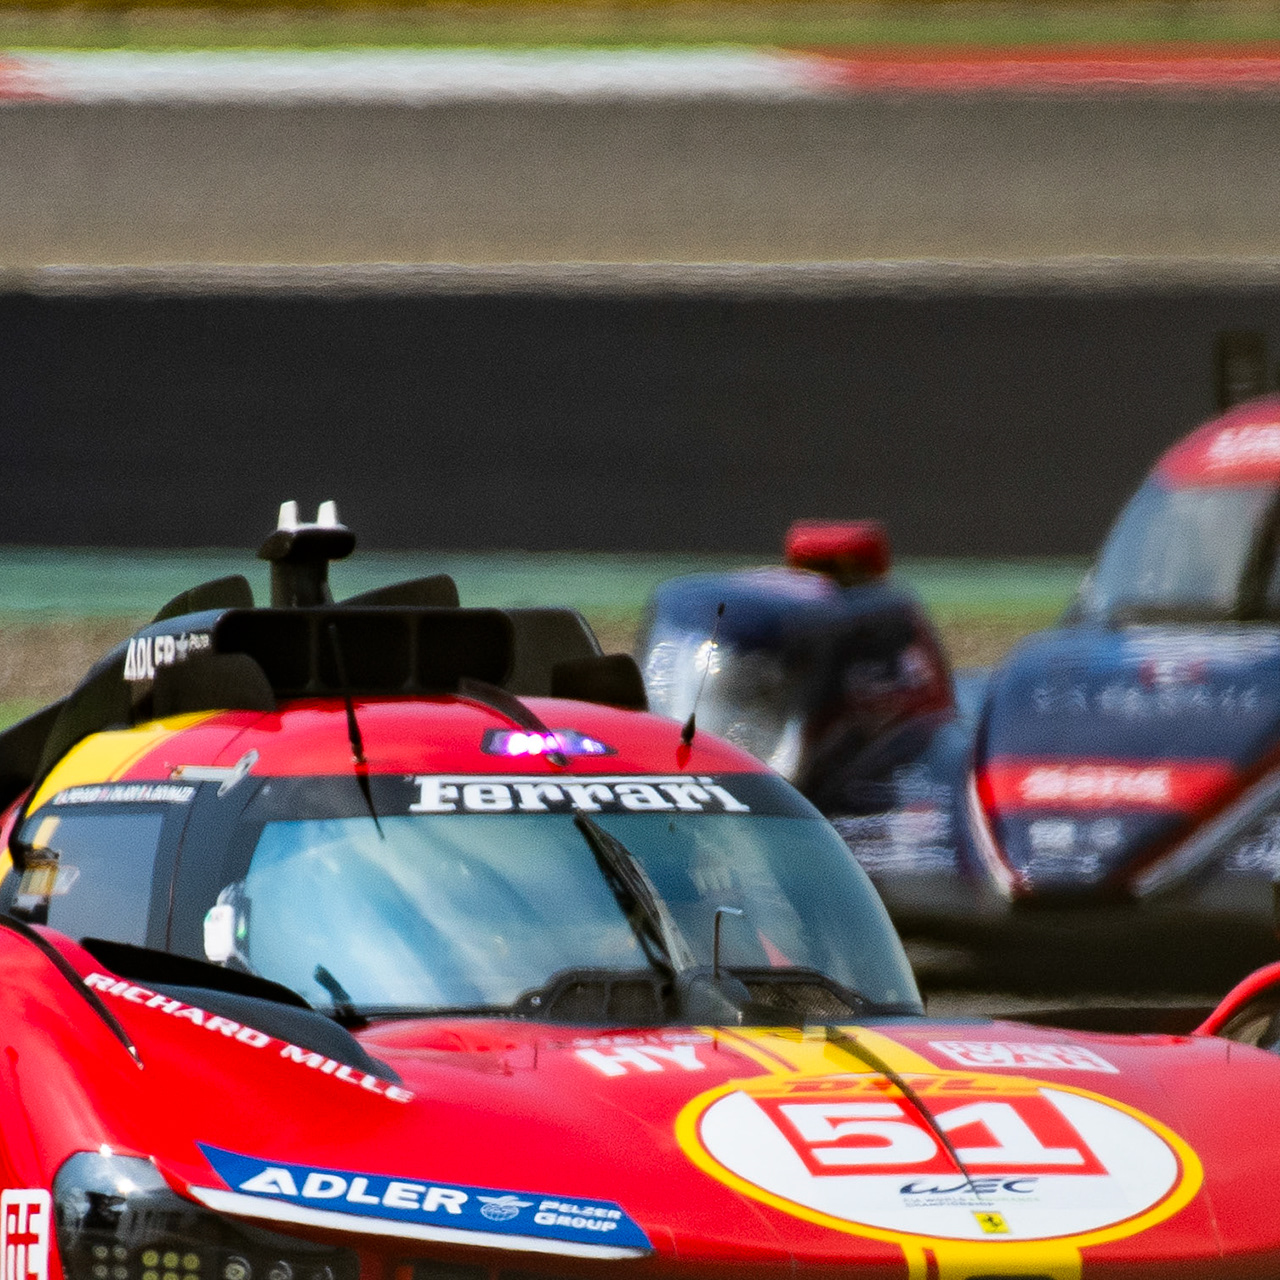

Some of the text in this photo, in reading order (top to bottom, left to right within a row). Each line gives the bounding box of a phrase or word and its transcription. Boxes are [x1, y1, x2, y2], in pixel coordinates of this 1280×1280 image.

[409, 776, 751, 813] Ferrari
[83, 972, 416, 1102] RICHARD MILLE
[575, 1044, 706, 1077] HY
[778, 1102, 1087, 1166] 51
[239, 1167, 469, 1215] ADLER
[899, 1177, 1039, 1194] WEC
[534, 1212, 617, 1232] GROUP
[539, 1200, 622, 1219] PELZER
